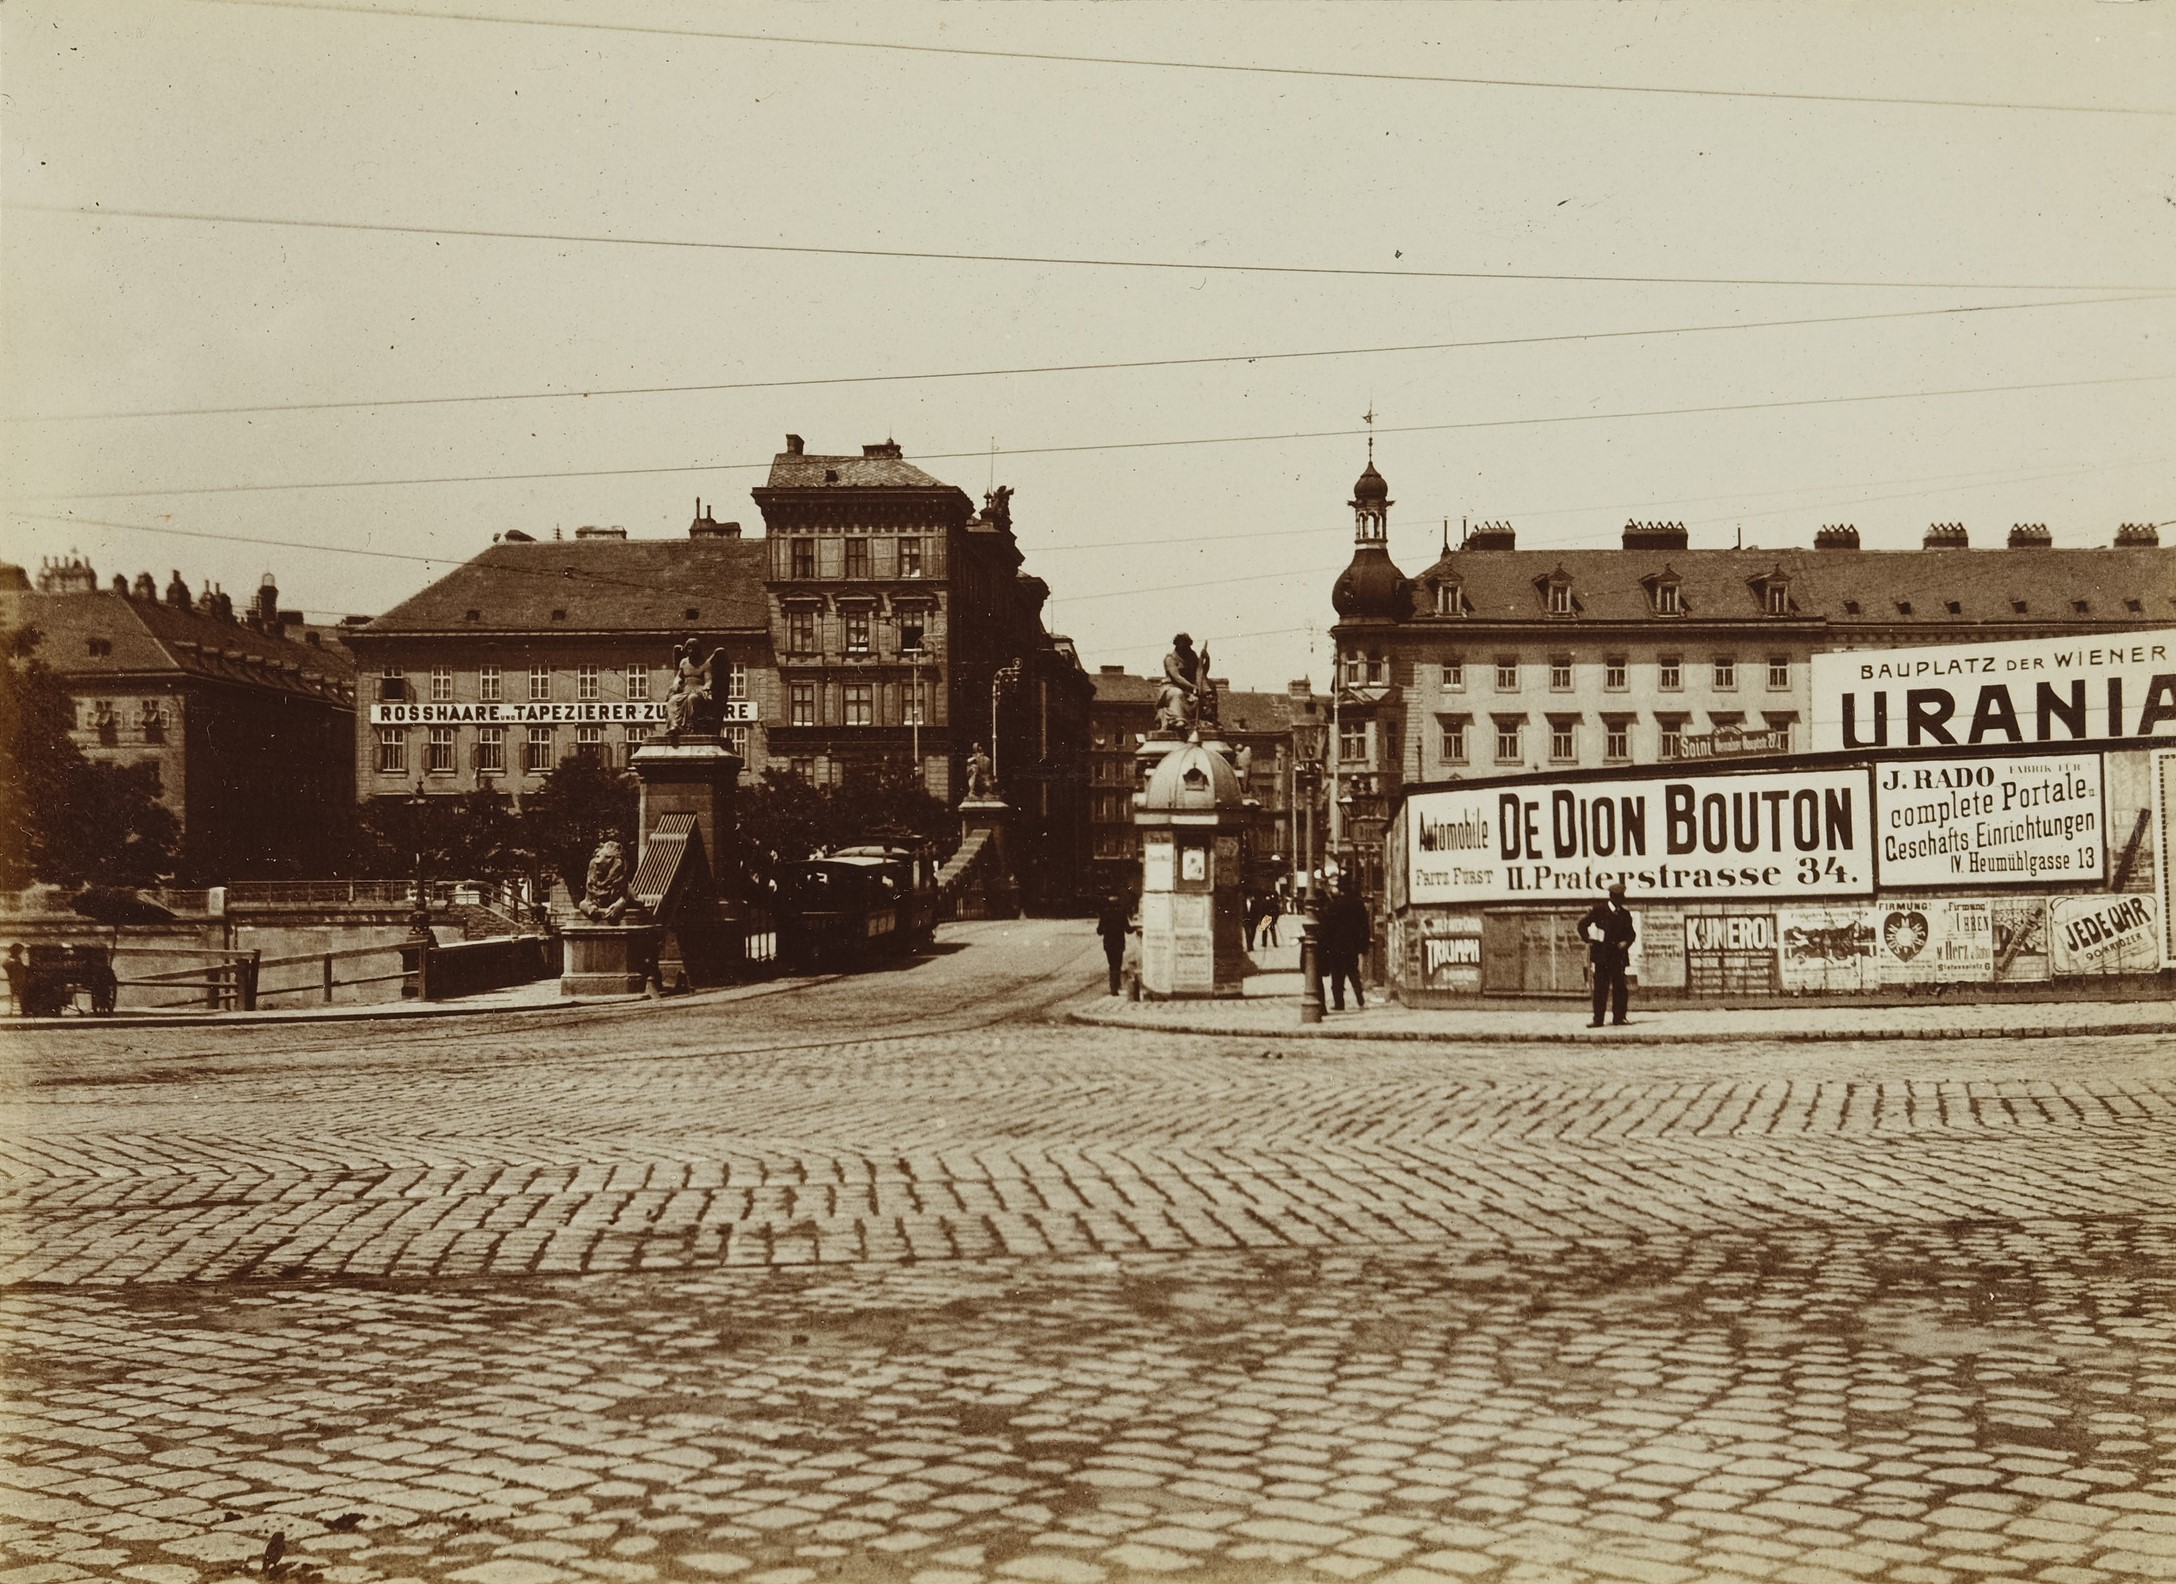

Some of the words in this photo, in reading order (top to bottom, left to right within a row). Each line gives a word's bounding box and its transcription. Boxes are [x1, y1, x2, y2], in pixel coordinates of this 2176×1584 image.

[1861, 656, 1996, 679] BAUPLATZ
[2006, 658, 2045, 671] DER
[2054, 645, 2167, 669] WIENER
[380, 705, 500, 721] ROSSHAARE
[1841, 674, 2176, 749] URANIA
[1882, 770, 1907, 791] J.
[1913, 766, 1995, 790] RADO
[1891, 790, 1994, 828] complete
[2001, 771, 2087, 812] Portale
[1419, 807, 1489, 852] Automobile
[1499, 792, 1543, 861] DE
[1552, 789, 1647, 859] DION
[1665, 783, 1854, 855] BOUTON
[1976, 812, 2096, 848] Einrichtungen
[1797, 856, 1858, 885] 34.
[1969, 849, 2070, 877] Heumühlgasse
[2077, 847, 2095, 869] 13
[2065, 911, 2114, 952] JEDE
[2107, 897, 2152, 933] UHR
